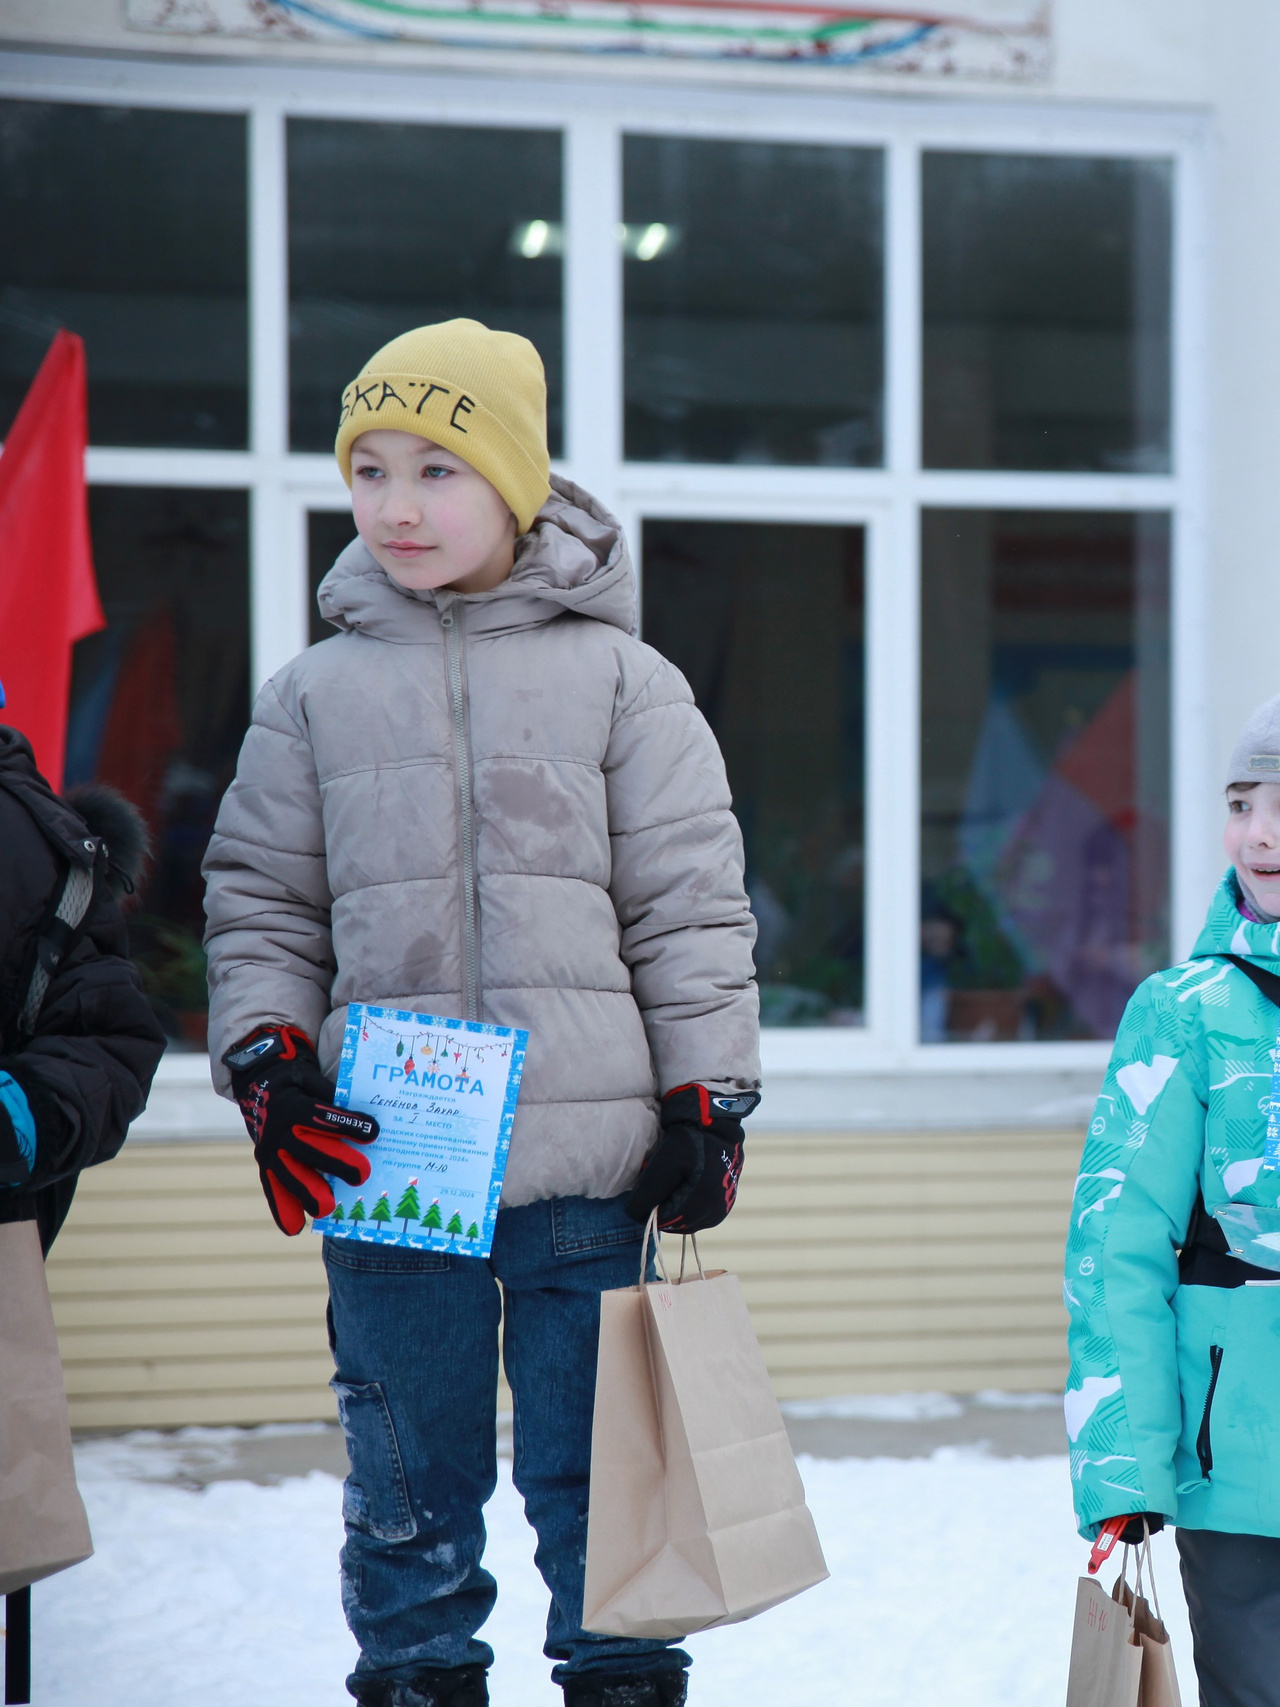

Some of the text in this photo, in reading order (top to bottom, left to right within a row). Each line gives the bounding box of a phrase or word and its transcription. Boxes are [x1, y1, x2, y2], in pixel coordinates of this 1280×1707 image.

[372, 1063, 485, 1096] ГРАМОТА
[399, 1089, 456, 1103] Награждается
[393, 1115, 403, 1123] ЗА
[425, 1119, 453, 1129] МЕСТО
[415, 1132, 477, 1146] соревнованиях
[418, 1142, 489, 1157] ориентированию
[421, 1150, 444, 1160] гонка
[393, 1160, 422, 1170] группе
[439, 1188, 475, 1199] 29.12.2024
